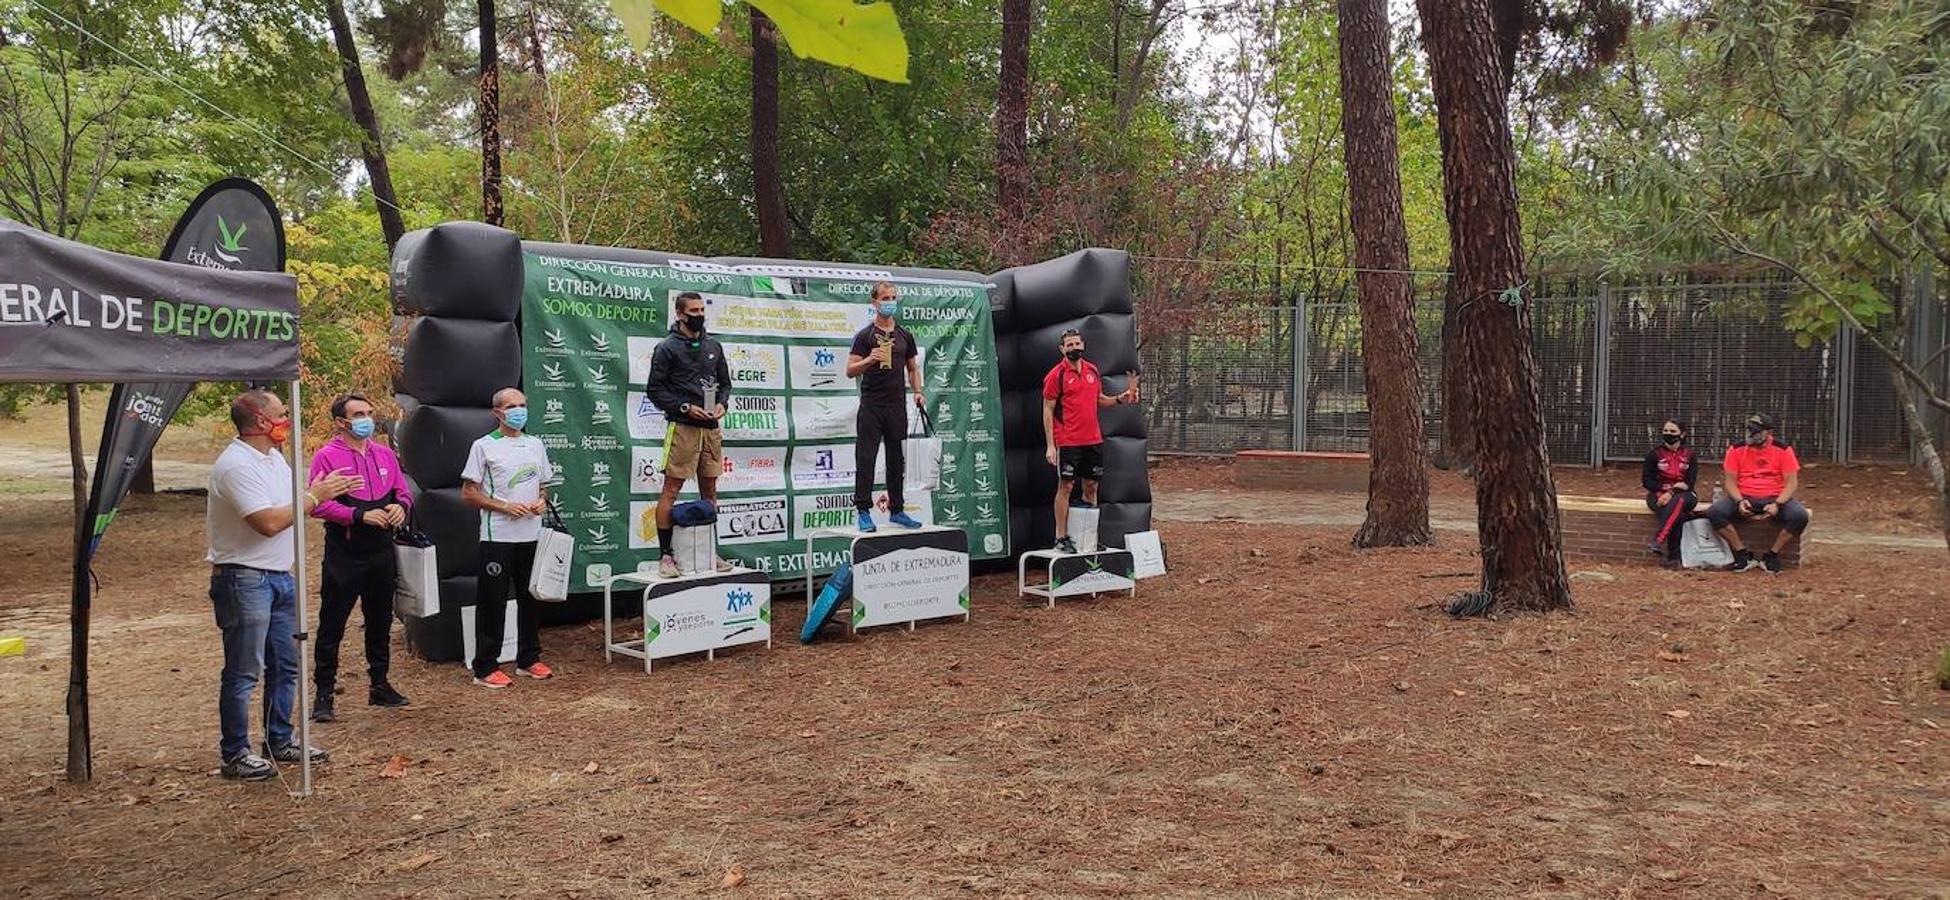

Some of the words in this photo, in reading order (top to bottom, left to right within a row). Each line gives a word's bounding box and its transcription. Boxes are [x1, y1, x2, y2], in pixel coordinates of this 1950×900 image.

[540, 255, 607, 273] DIRECCIÓN
[610, 266, 667, 279] GENERAL
[682, 272, 732, 285] DEPORTES
[548, 276, 654, 301] EXTREMADURA
[828, 283, 873, 295] DIRECCIÓ
[896, 285, 921, 296] ERAL
[922, 287, 932, 296] DE
[934, 287, 974, 298] DEPORTES
[101, 294, 143, 332] DE
[153, 300, 297, 341] DEPORTES
[543, 298, 593, 318] SOMOS
[596, 303, 657, 322] DEPORTE
[903, 306, 975, 320] EXTREMADURA
[903, 323, 936, 338] OMOS
[939, 324, 977, 338] DEPORTE
[731, 369, 767, 383] LEGRE
[734, 397, 776, 411] SOMOS
[724, 412, 779, 430] DEPORTE
[816, 495, 857, 509] SOMOS
[803, 510, 856, 529] DEPORTE
[755, 557, 773, 573] DE
[862, 563, 887, 577] JUNTA
[891, 560, 901, 573] DE
[904, 555, 961, 572] EXTREMADURA
